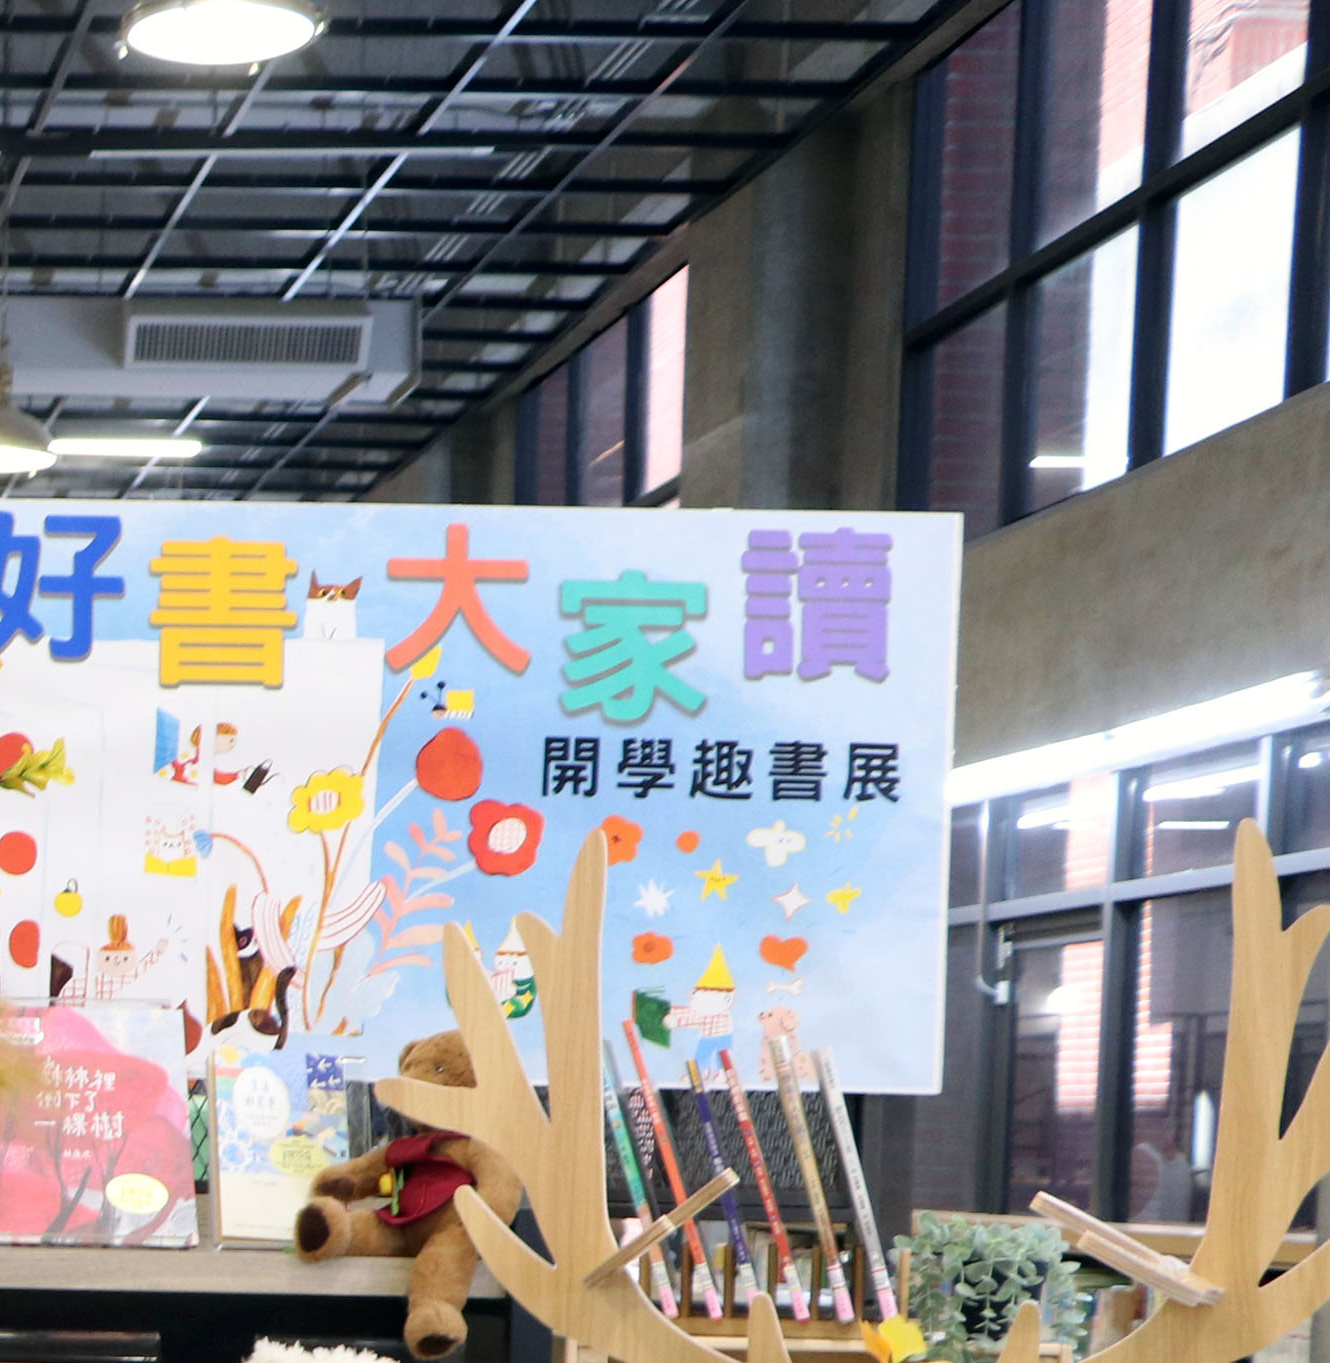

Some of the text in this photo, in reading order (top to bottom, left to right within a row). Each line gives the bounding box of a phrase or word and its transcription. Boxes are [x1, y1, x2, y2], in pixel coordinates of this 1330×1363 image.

[541, 736, 902, 804] 開學趣書展
[34, 1110, 125, 1140] 一棵樹
